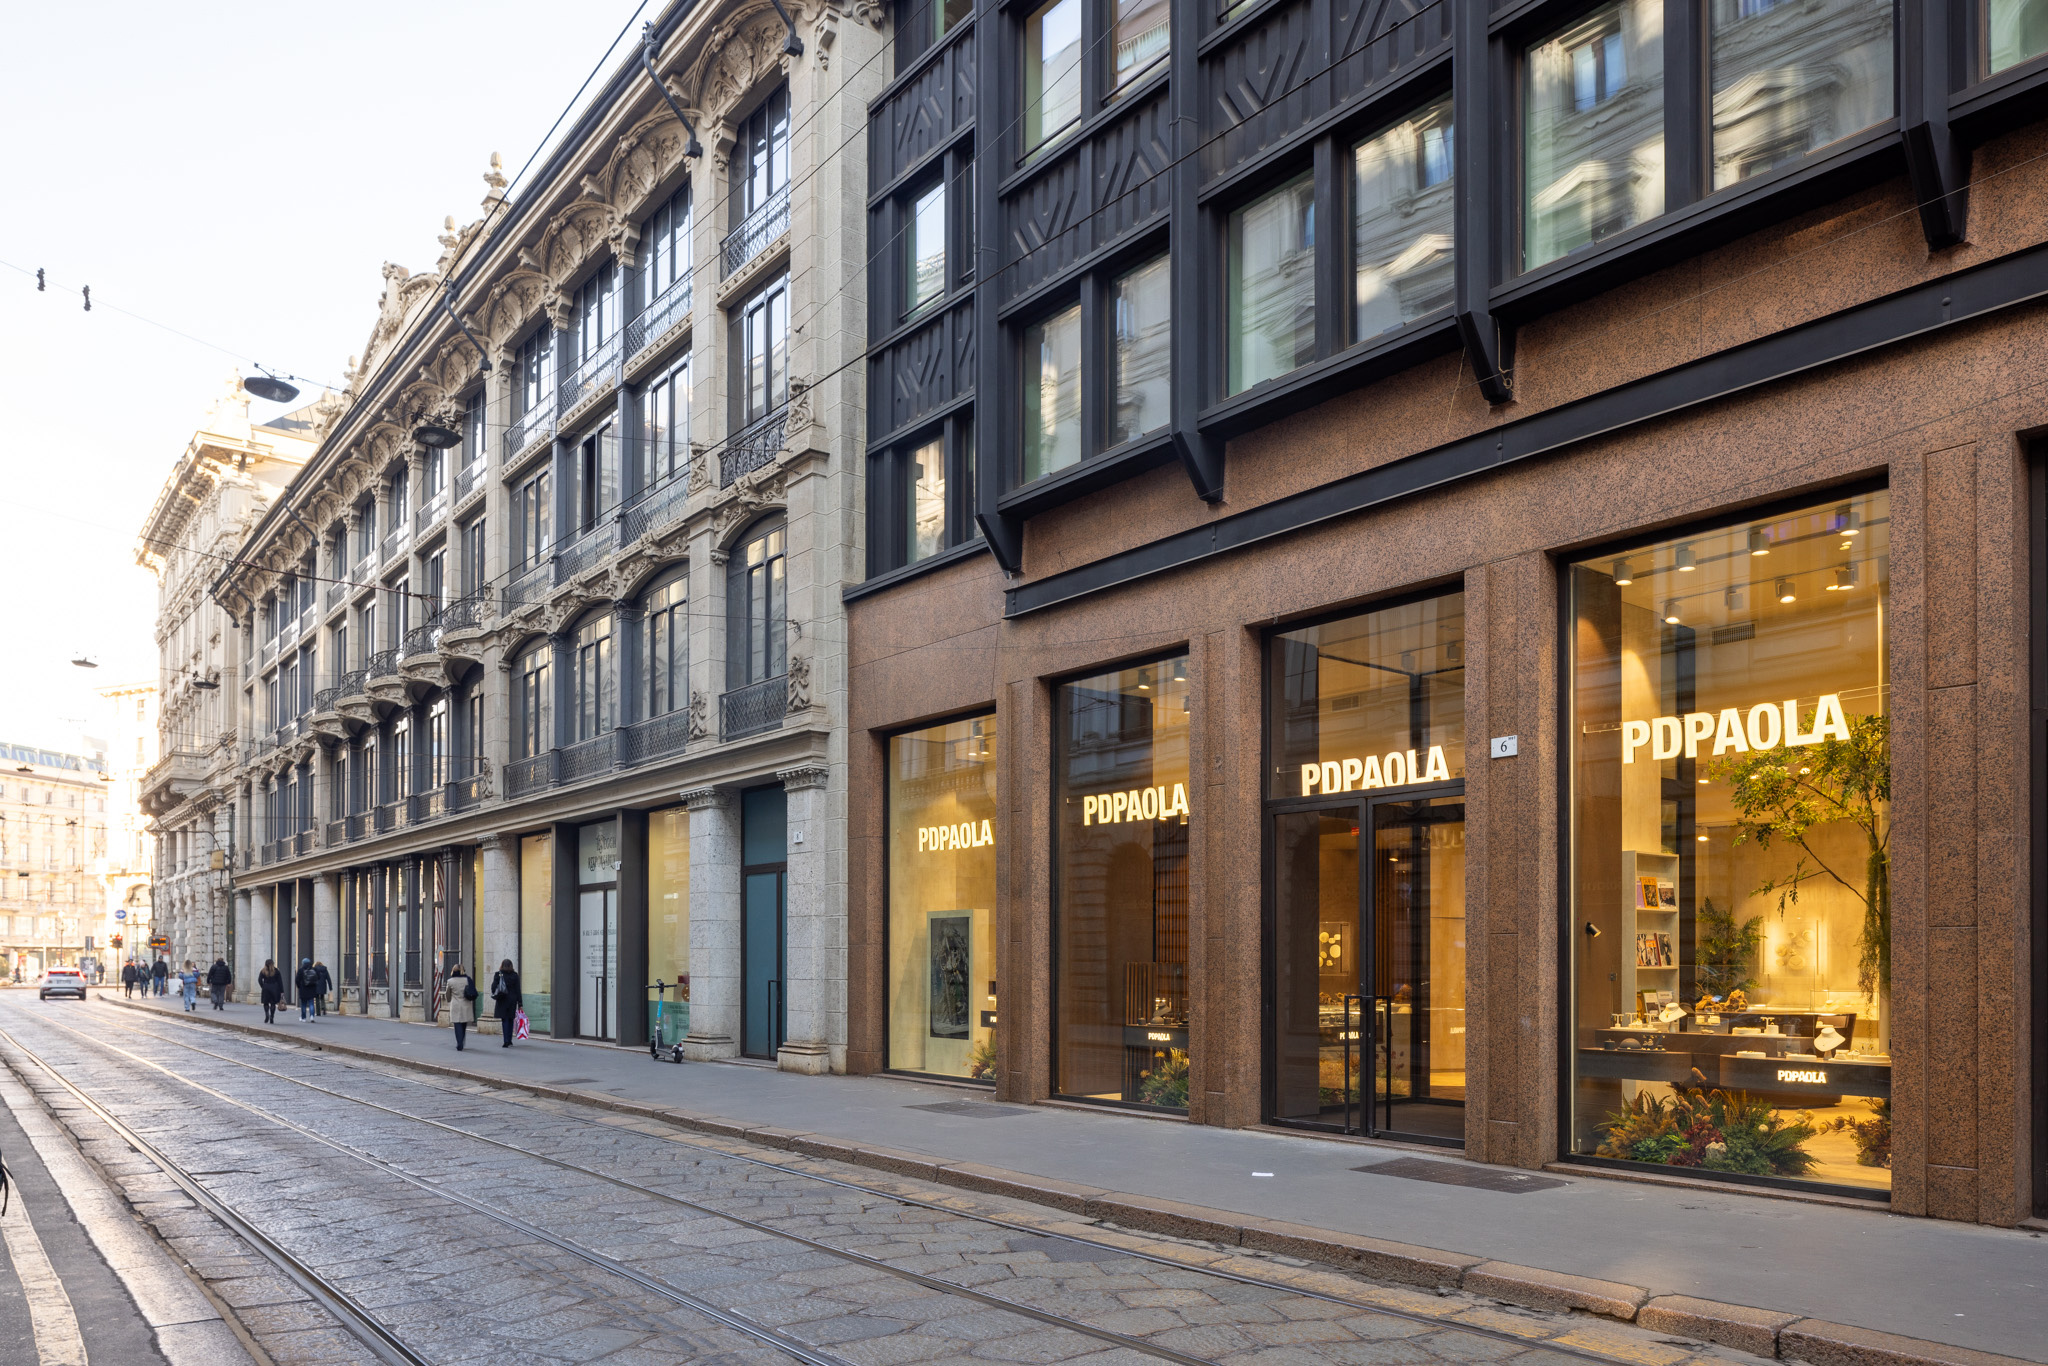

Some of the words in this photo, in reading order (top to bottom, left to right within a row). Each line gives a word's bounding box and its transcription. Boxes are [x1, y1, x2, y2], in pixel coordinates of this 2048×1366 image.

[1500, 740, 1508, 753] 6
[1622, 693, 1851, 765] PDPAOLA
[1301, 745, 1450, 797] PDPAOLA
[1083, 783, 1190, 826] PDPAOLA
[918, 819, 994, 852] PDPAOLA
[1777, 1069, 1827, 1084] PDPAOLA
